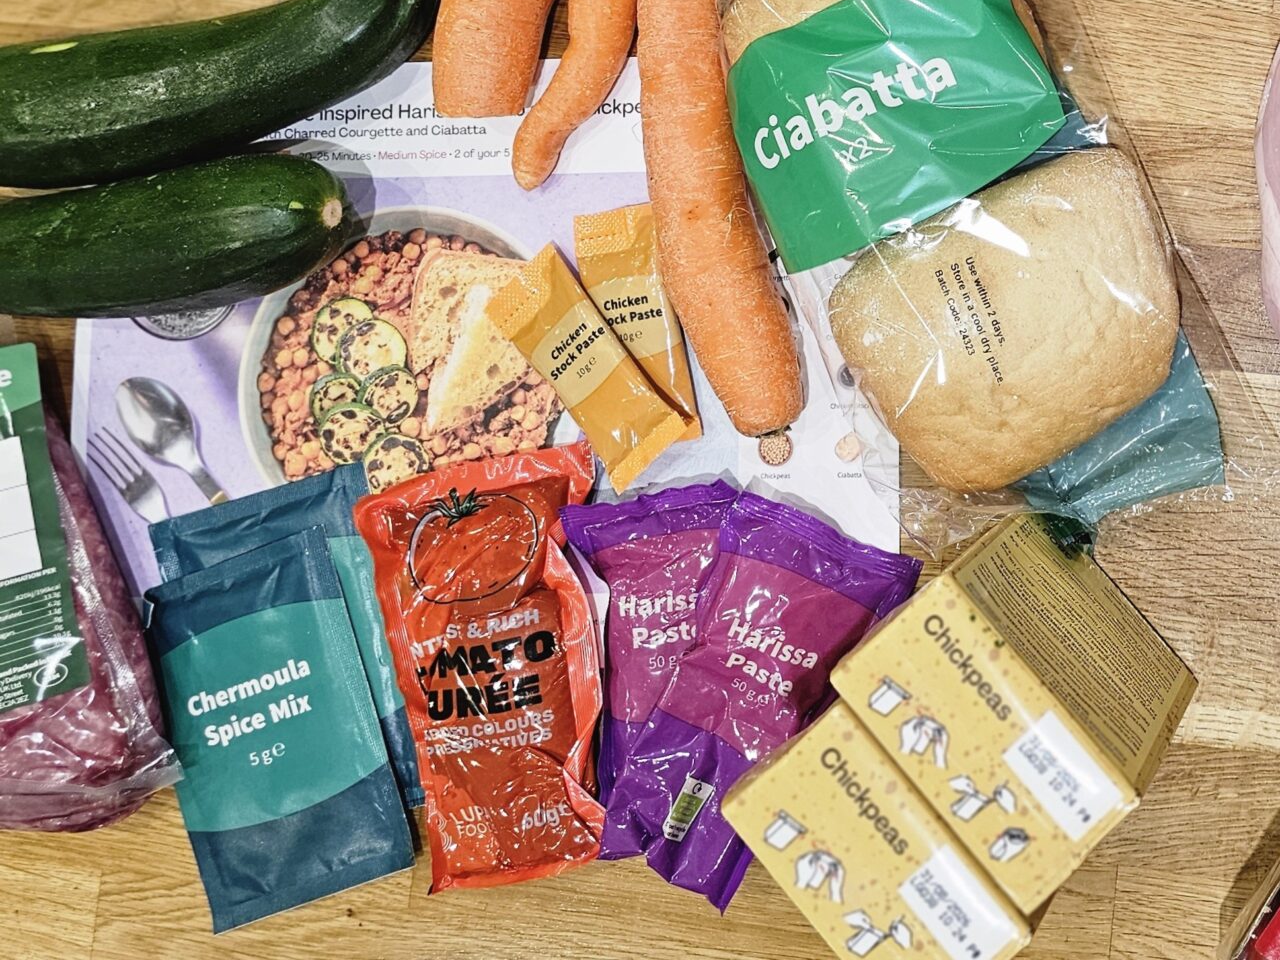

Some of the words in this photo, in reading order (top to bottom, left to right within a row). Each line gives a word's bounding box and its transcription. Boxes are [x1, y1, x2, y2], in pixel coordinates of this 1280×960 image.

[285, 127, 335, 139] Charred
[339, 126, 403, 140] Courgette
[406, 126, 428, 136] and
[431, 124, 487, 136] Ciabatta
[319, 103, 393, 124] Inspired
[754, 57, 957, 169] Ciabatta
[332, 151, 371, 161] Minutes
[379, 150, 416, 160] Medium
[419, 149, 447, 162] Spice
[464, 148, 475, 158] of
[478, 149, 500, 160] your
[935, 269, 951, 297] Batch
[951, 262, 966, 291] Store
[603, 293, 649, 311] Chicken
[629, 306, 664, 325] Paste
[966, 256, 978, 276] Use
[974, 277, 992, 309] within
[992, 319, 1006, 347] days.
[551, 322, 588, 361] Chicken
[551, 351, 577, 381] Stock
[575, 326, 605, 355] Paste
[649, 657, 665, 669] 50
[727, 617, 819, 671] Harissa
[187, 659, 311, 717] Chermoula
[726, 652, 794, 698] Paste
[923, 614, 1013, 722] Chickpeas
[204, 715, 266, 747] Spice
[268, 694, 312, 723] Mix
[820, 747, 910, 856] Chickpeas
